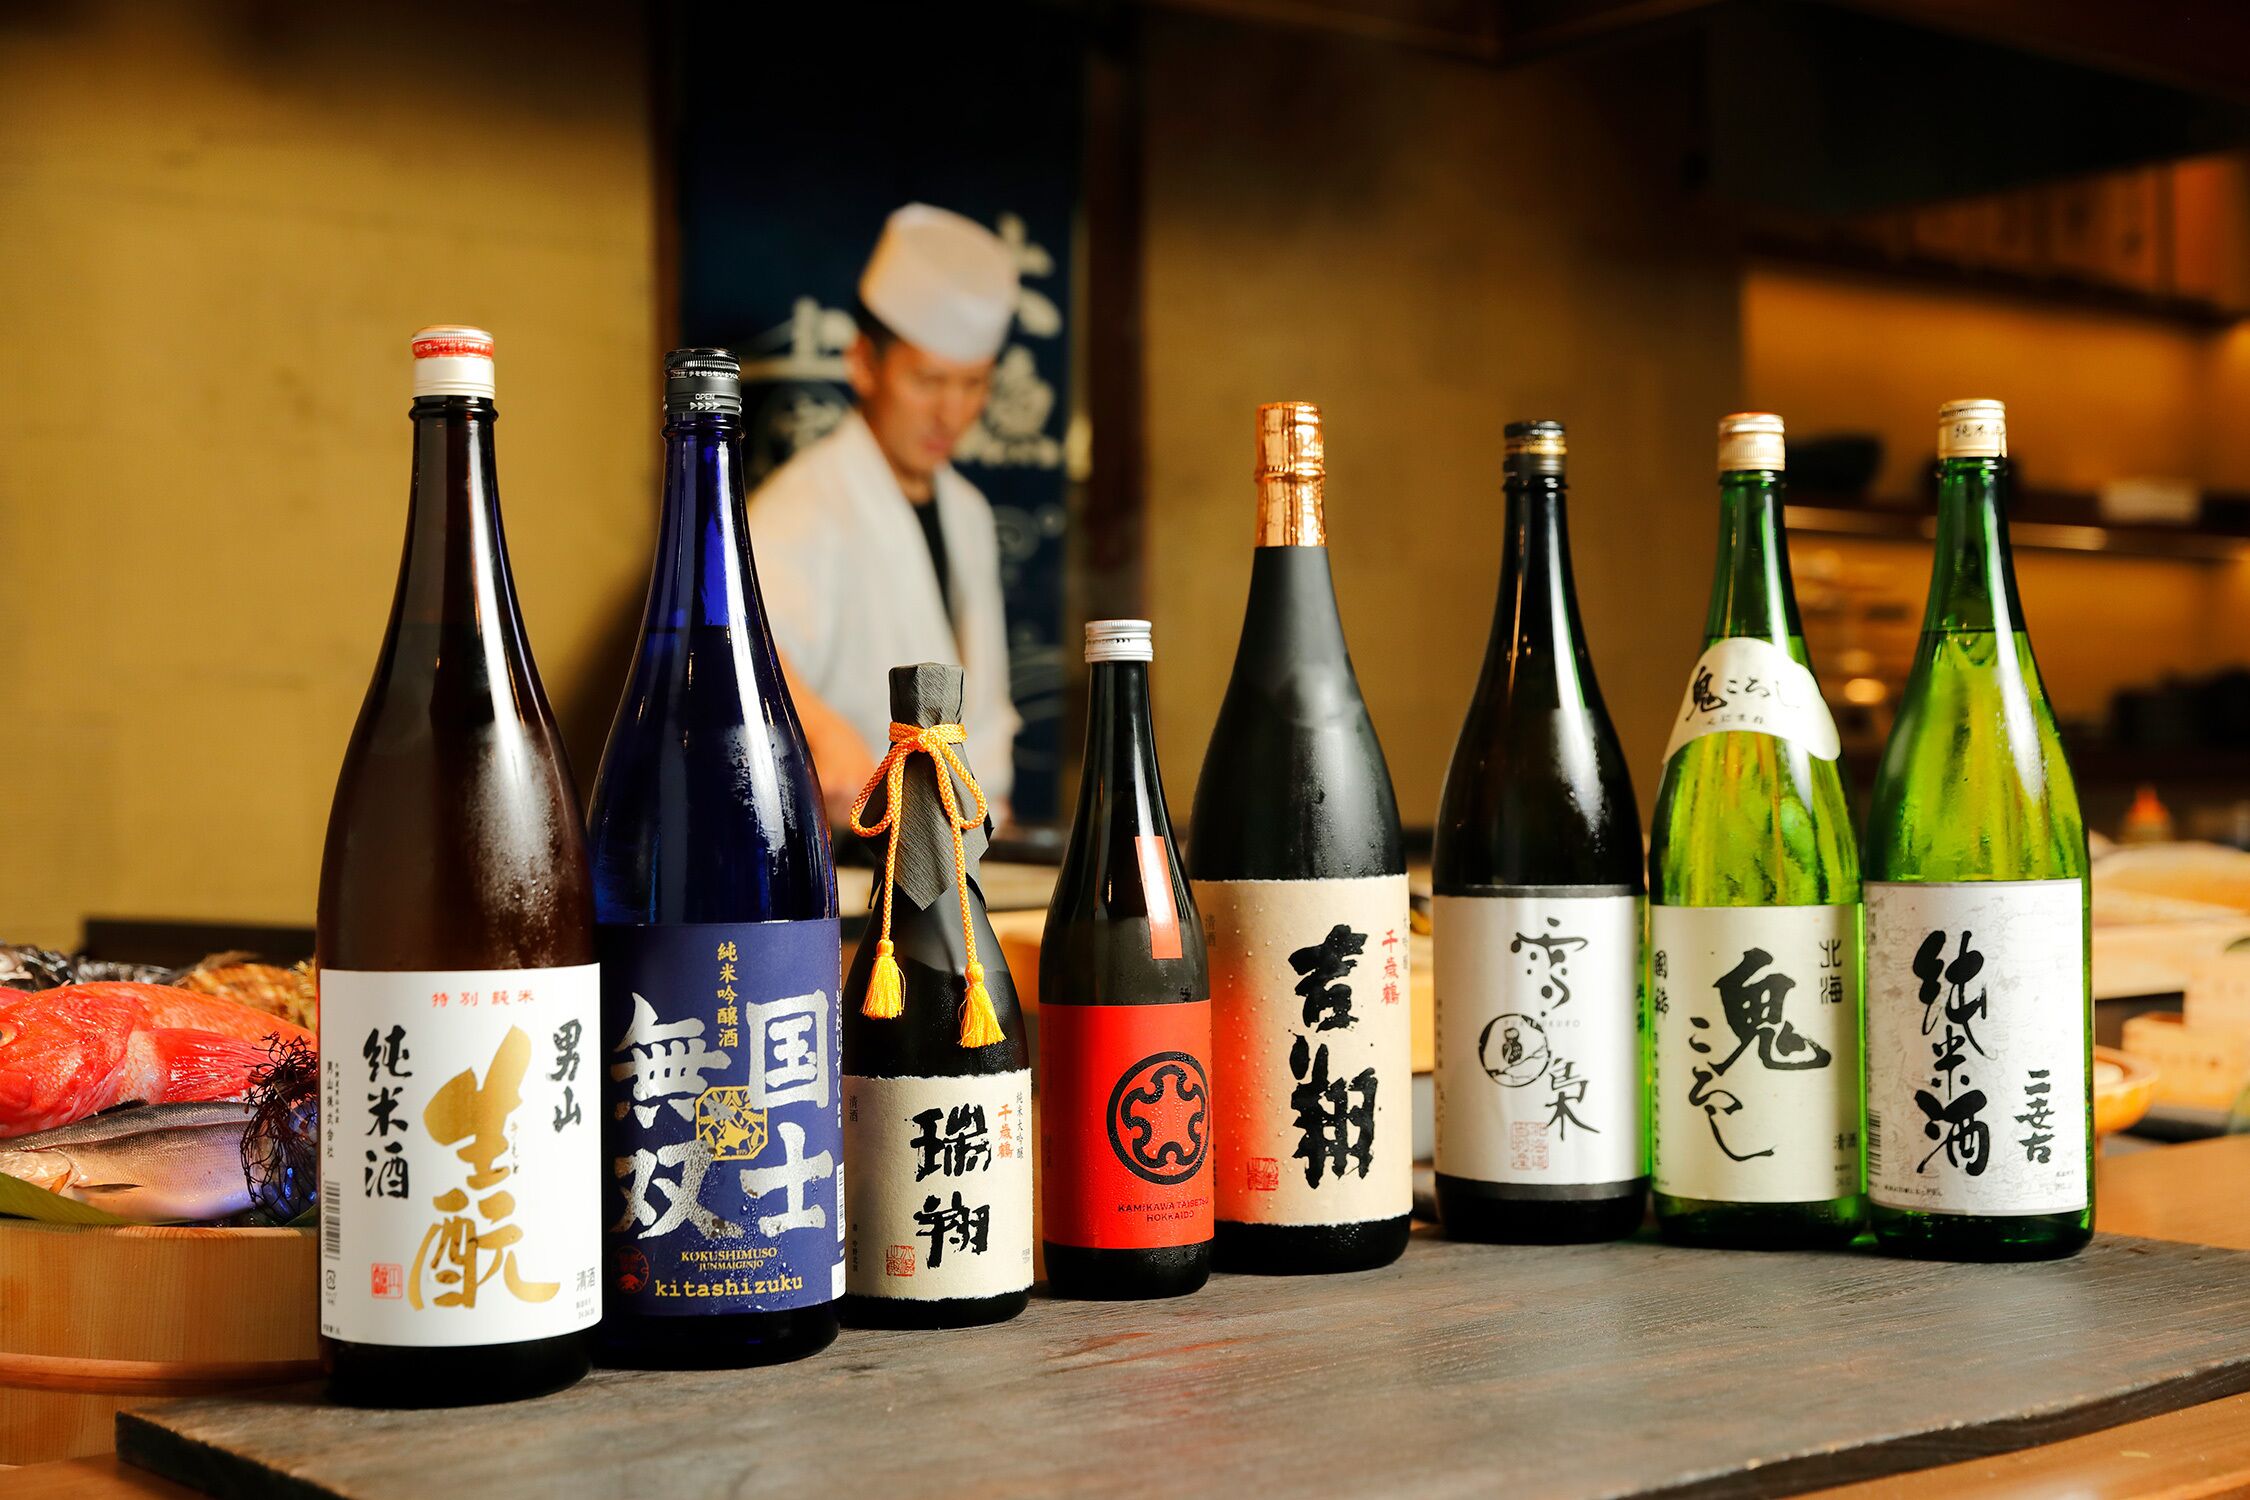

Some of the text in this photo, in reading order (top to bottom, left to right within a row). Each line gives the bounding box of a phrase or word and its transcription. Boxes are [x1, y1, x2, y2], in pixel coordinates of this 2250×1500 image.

[695, 393, 716, 401] OPEN
[717, 941, 739, 1049] 純米吟醸酒
[1288, 923, 1378, 1190] 吉翔
[1912, 930, 1993, 1177] 純米酒
[549, 1018, 583, 1134] 男山
[363, 1024, 414, 1200] 純米酒
[849, 1095, 858, 1123] 清酒
[1117, 1202, 1175, 1213] KAMIKAWA
[1146, 1210, 1195, 1222] HOKKAIDO
[681, 1247, 778, 1262] KOKUSHIMUSO
[699, 1260, 765, 1271] JUNMAIGINJO
[576, 1266, 596, 1292] 清酒
[655, 1273, 803, 1298] kitashizuku
